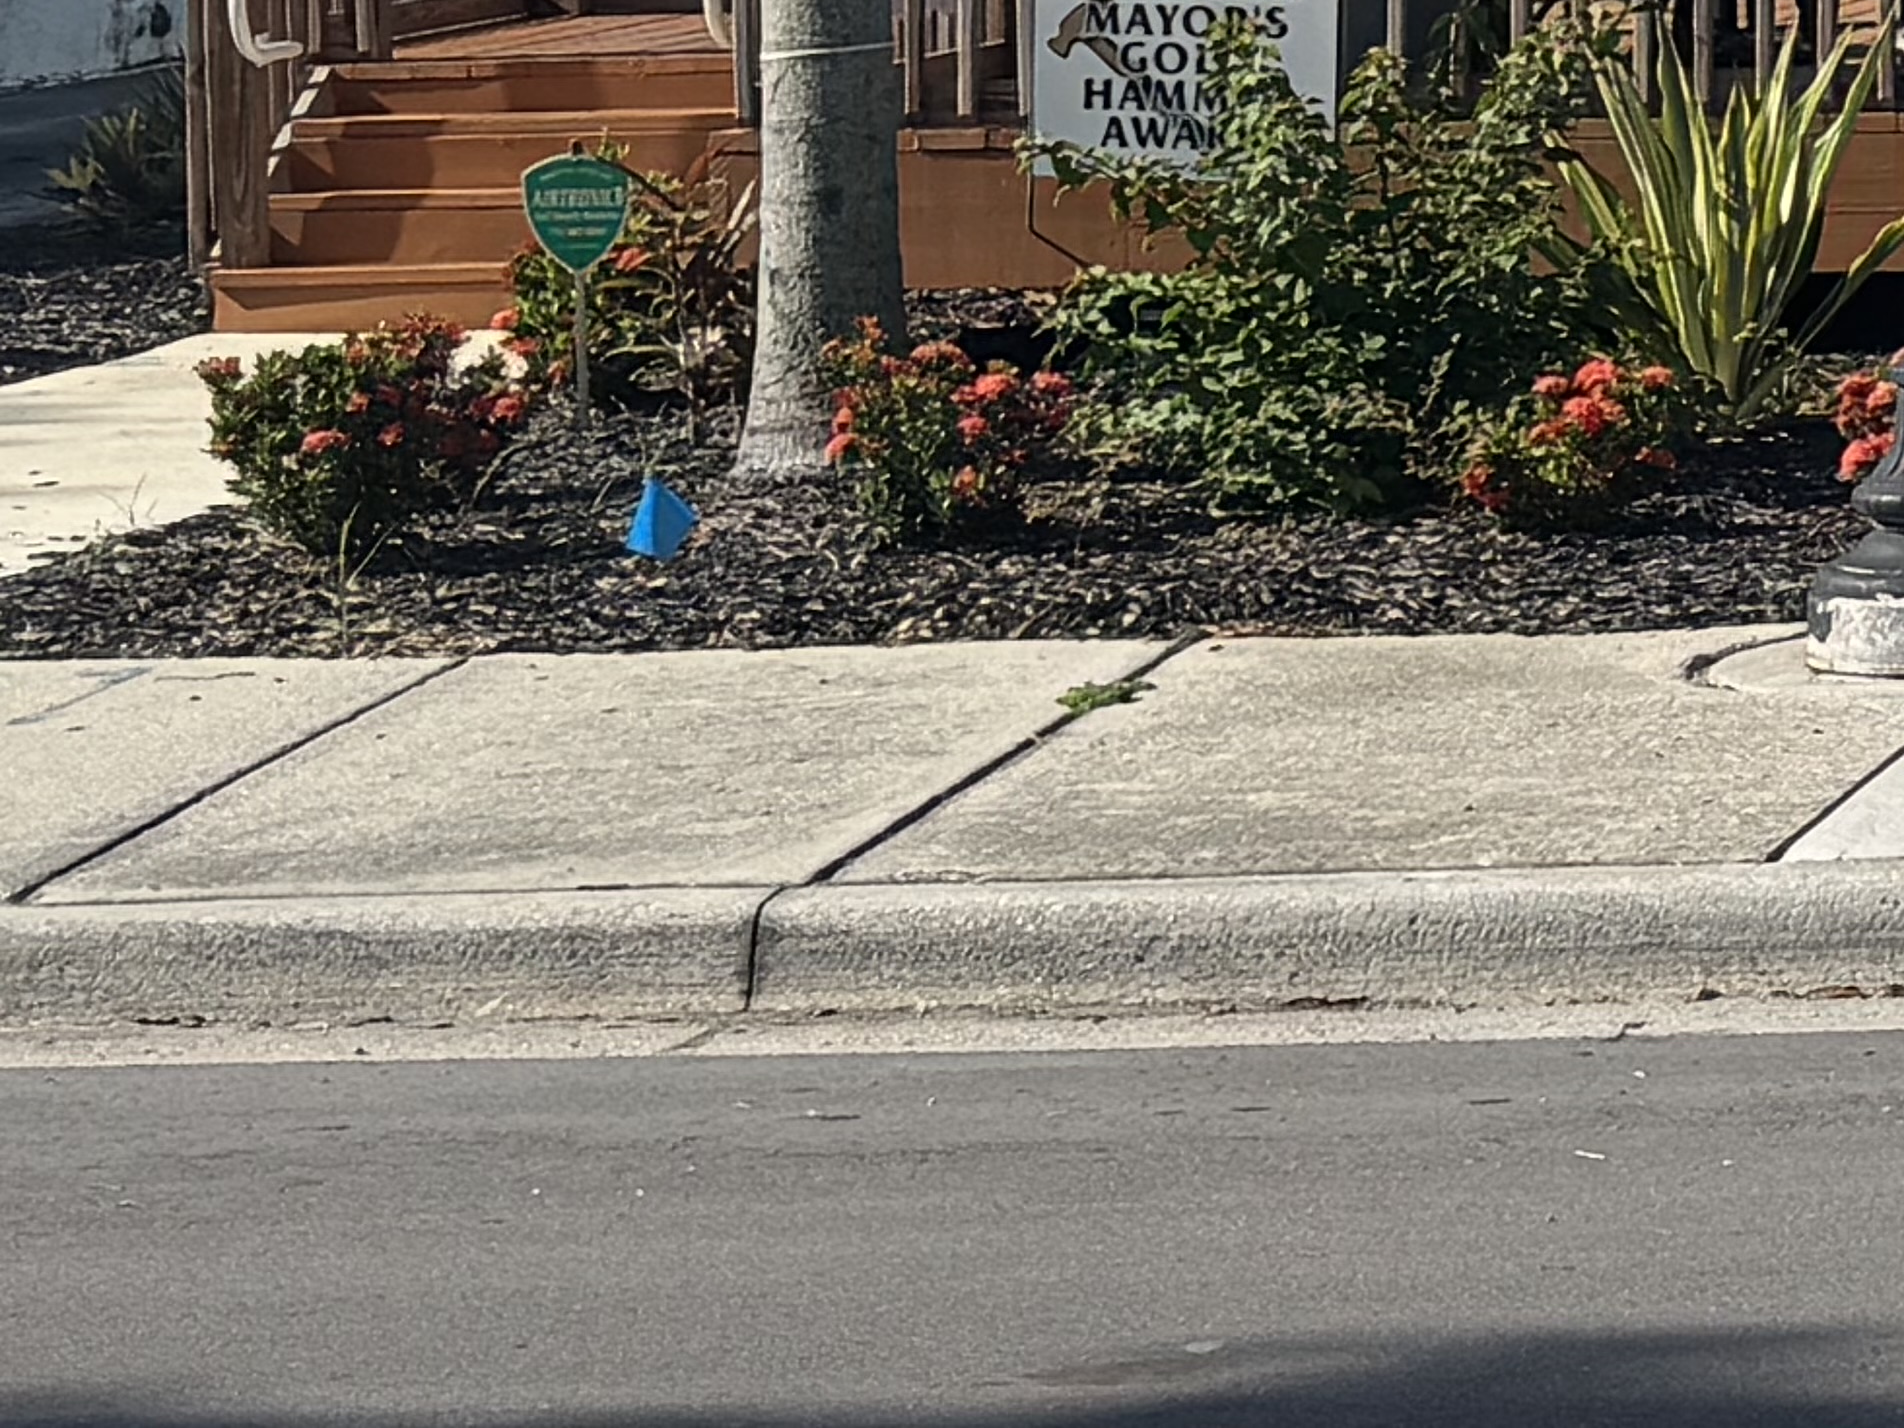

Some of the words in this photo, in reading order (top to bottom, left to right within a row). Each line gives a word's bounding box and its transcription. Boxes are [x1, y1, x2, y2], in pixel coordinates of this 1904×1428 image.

[1120, 41, 1216, 74] GOL
[1083, 78, 1230, 111] HAMM
[1100, 116, 1226, 150] AWAR
